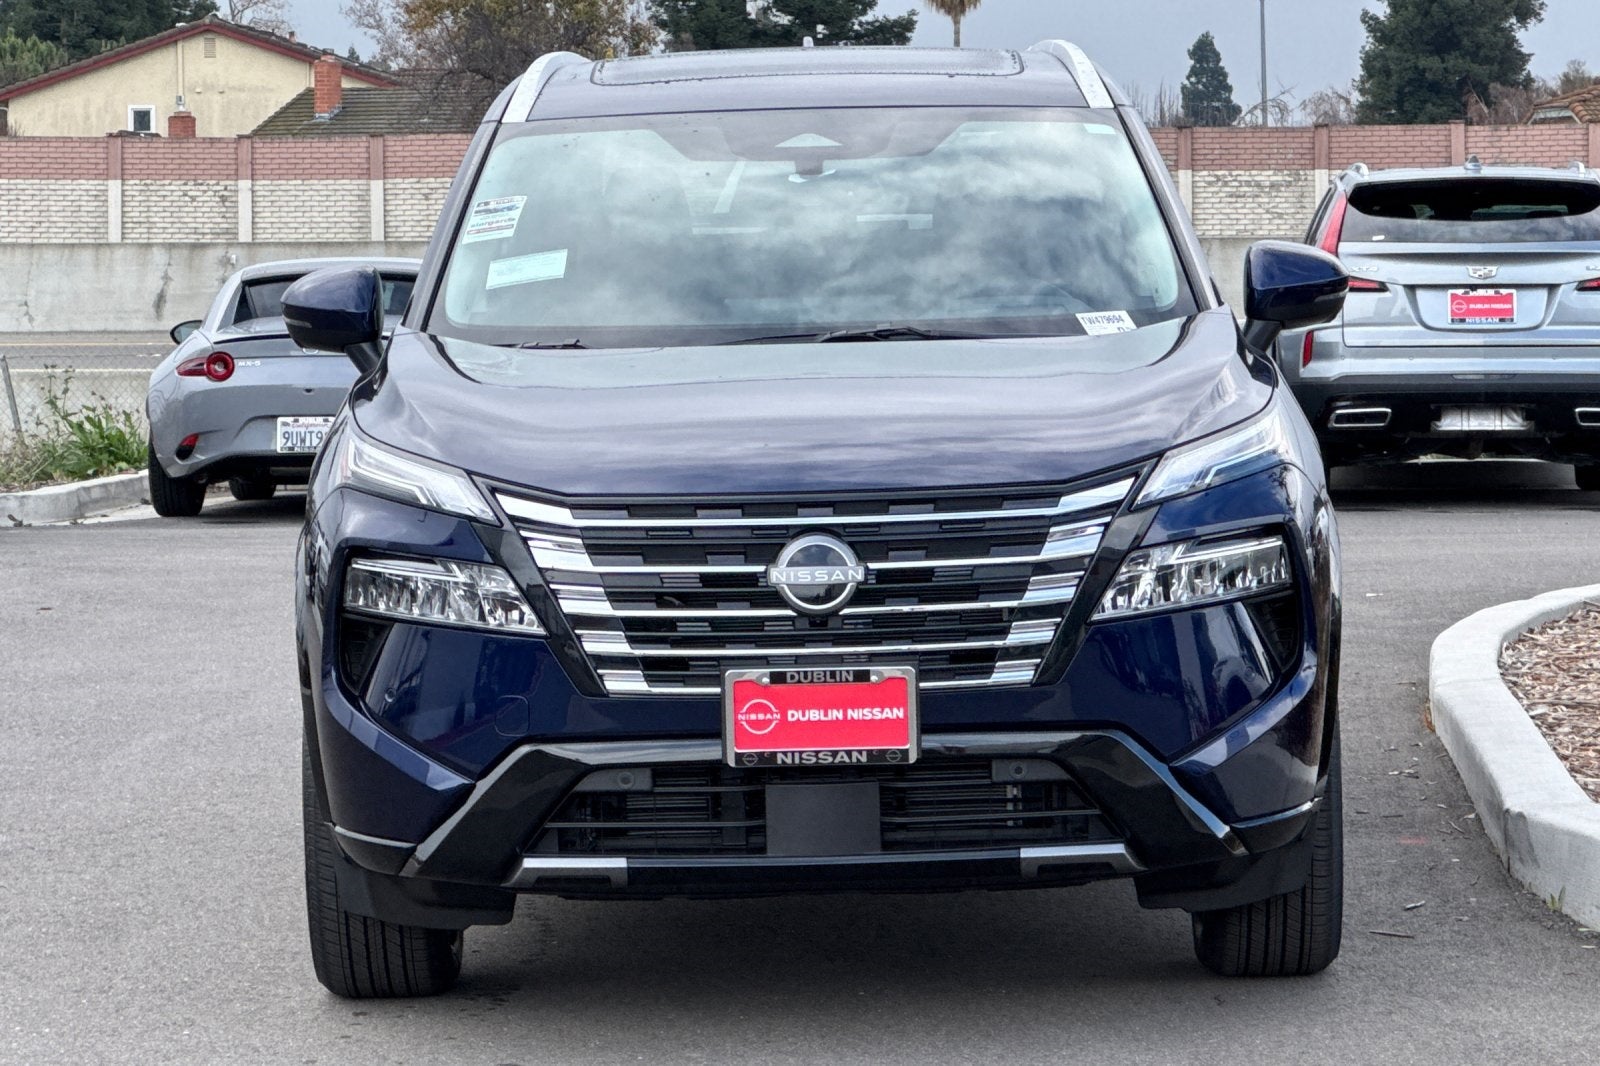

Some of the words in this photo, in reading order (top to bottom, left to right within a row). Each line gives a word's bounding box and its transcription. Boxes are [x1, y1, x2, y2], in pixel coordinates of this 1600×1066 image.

[283, 431, 328, 446] 9UWT9
[772, 569, 862, 582] NISSAN
[786, 670, 854, 683] DUBLIN
[738, 713, 781, 721] NISSAN
[787, 709, 844, 721] DUBLIN
[847, 707, 904, 720] NISSAN
[776, 750, 868, 764] NISSAN
